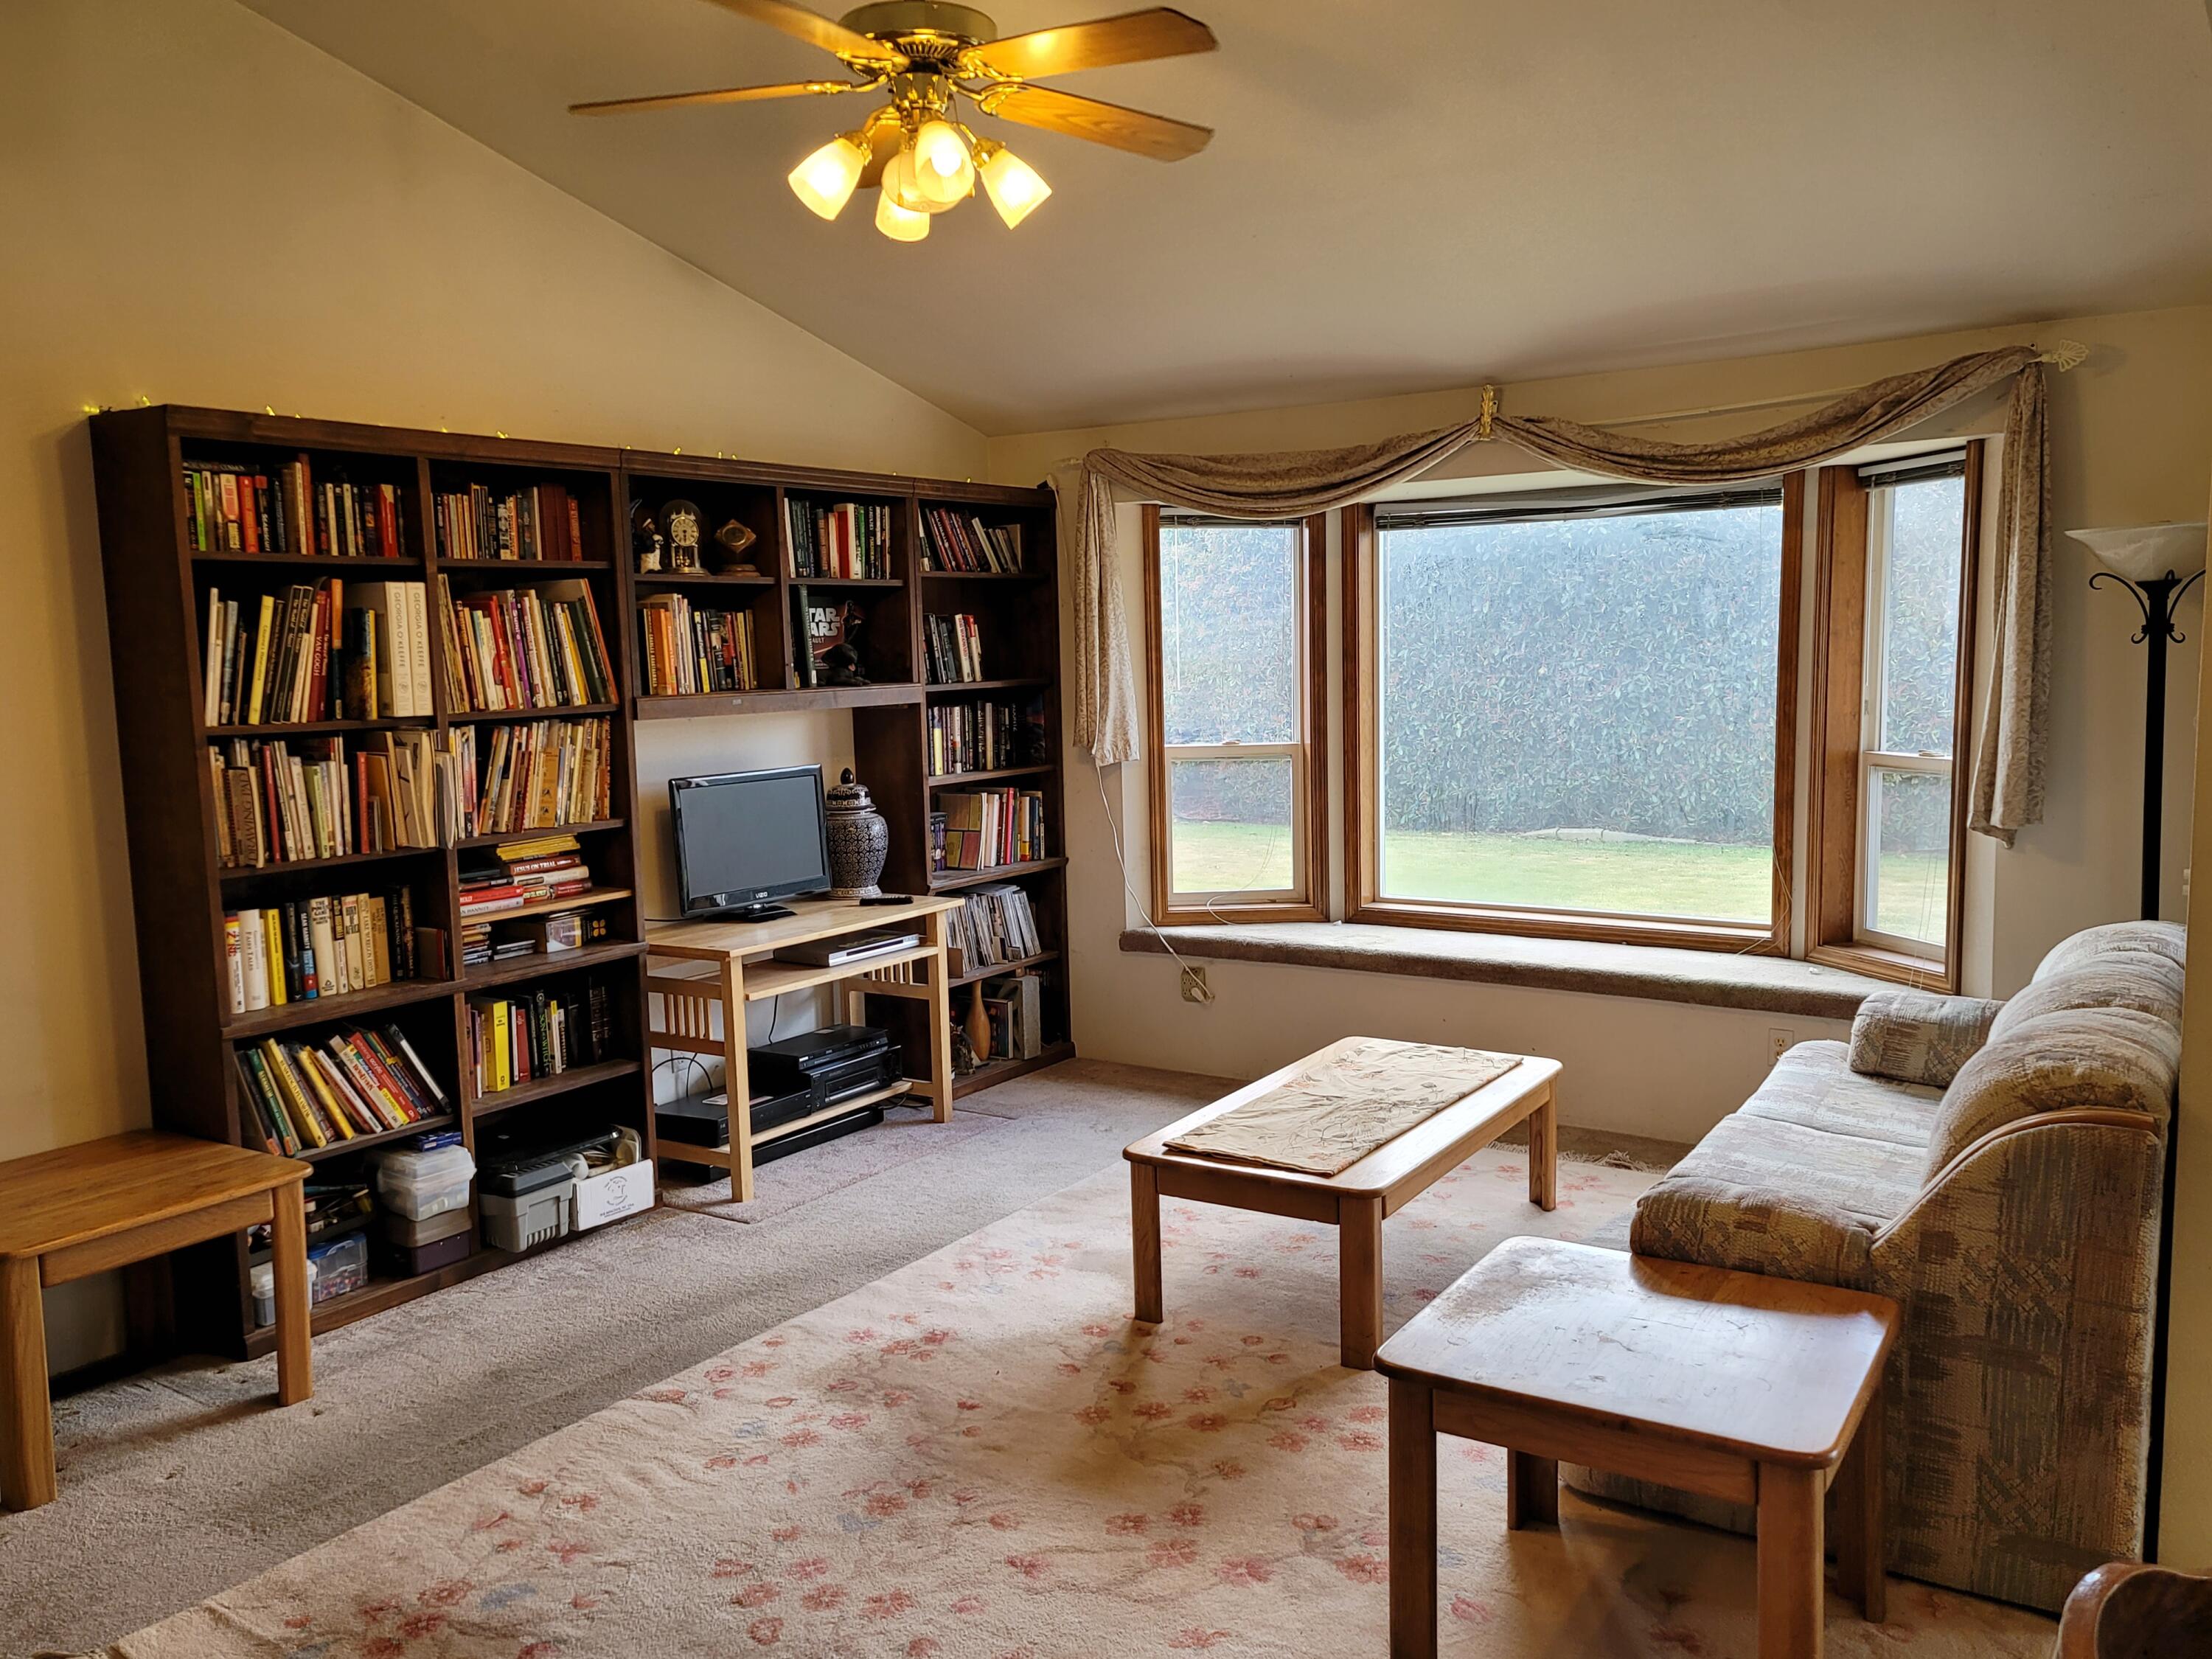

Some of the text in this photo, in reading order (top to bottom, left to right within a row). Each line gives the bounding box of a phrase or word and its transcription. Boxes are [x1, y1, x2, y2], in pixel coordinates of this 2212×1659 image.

[261, 512, 271, 552] SEABISCUIT
[393, 591, 406, 667] GEORGIA O'KEEFFE
[413, 592, 424, 667] GEORGIA O'KEEFFE
[809, 608, 839, 622] TAR
[810, 622, 840, 636] ARS
[313, 636, 322, 676] VAN GOGH
[238, 772, 257, 861] DRAWING PAD
[513, 864, 530, 873] JESUS
[539, 860, 555, 869] TRIAL
[299, 912, 311, 949] SEAN HANNITY
[244, 931, 255, 970] FAIRY TALES
[538, 1013, 546, 1032] SON
[368, 1056, 384, 1075] acrylic
[540, 1039, 550, 1066] WITCH
[358, 1057, 372, 1073] Acrylic
[367, 1071, 381, 1087] Painting
